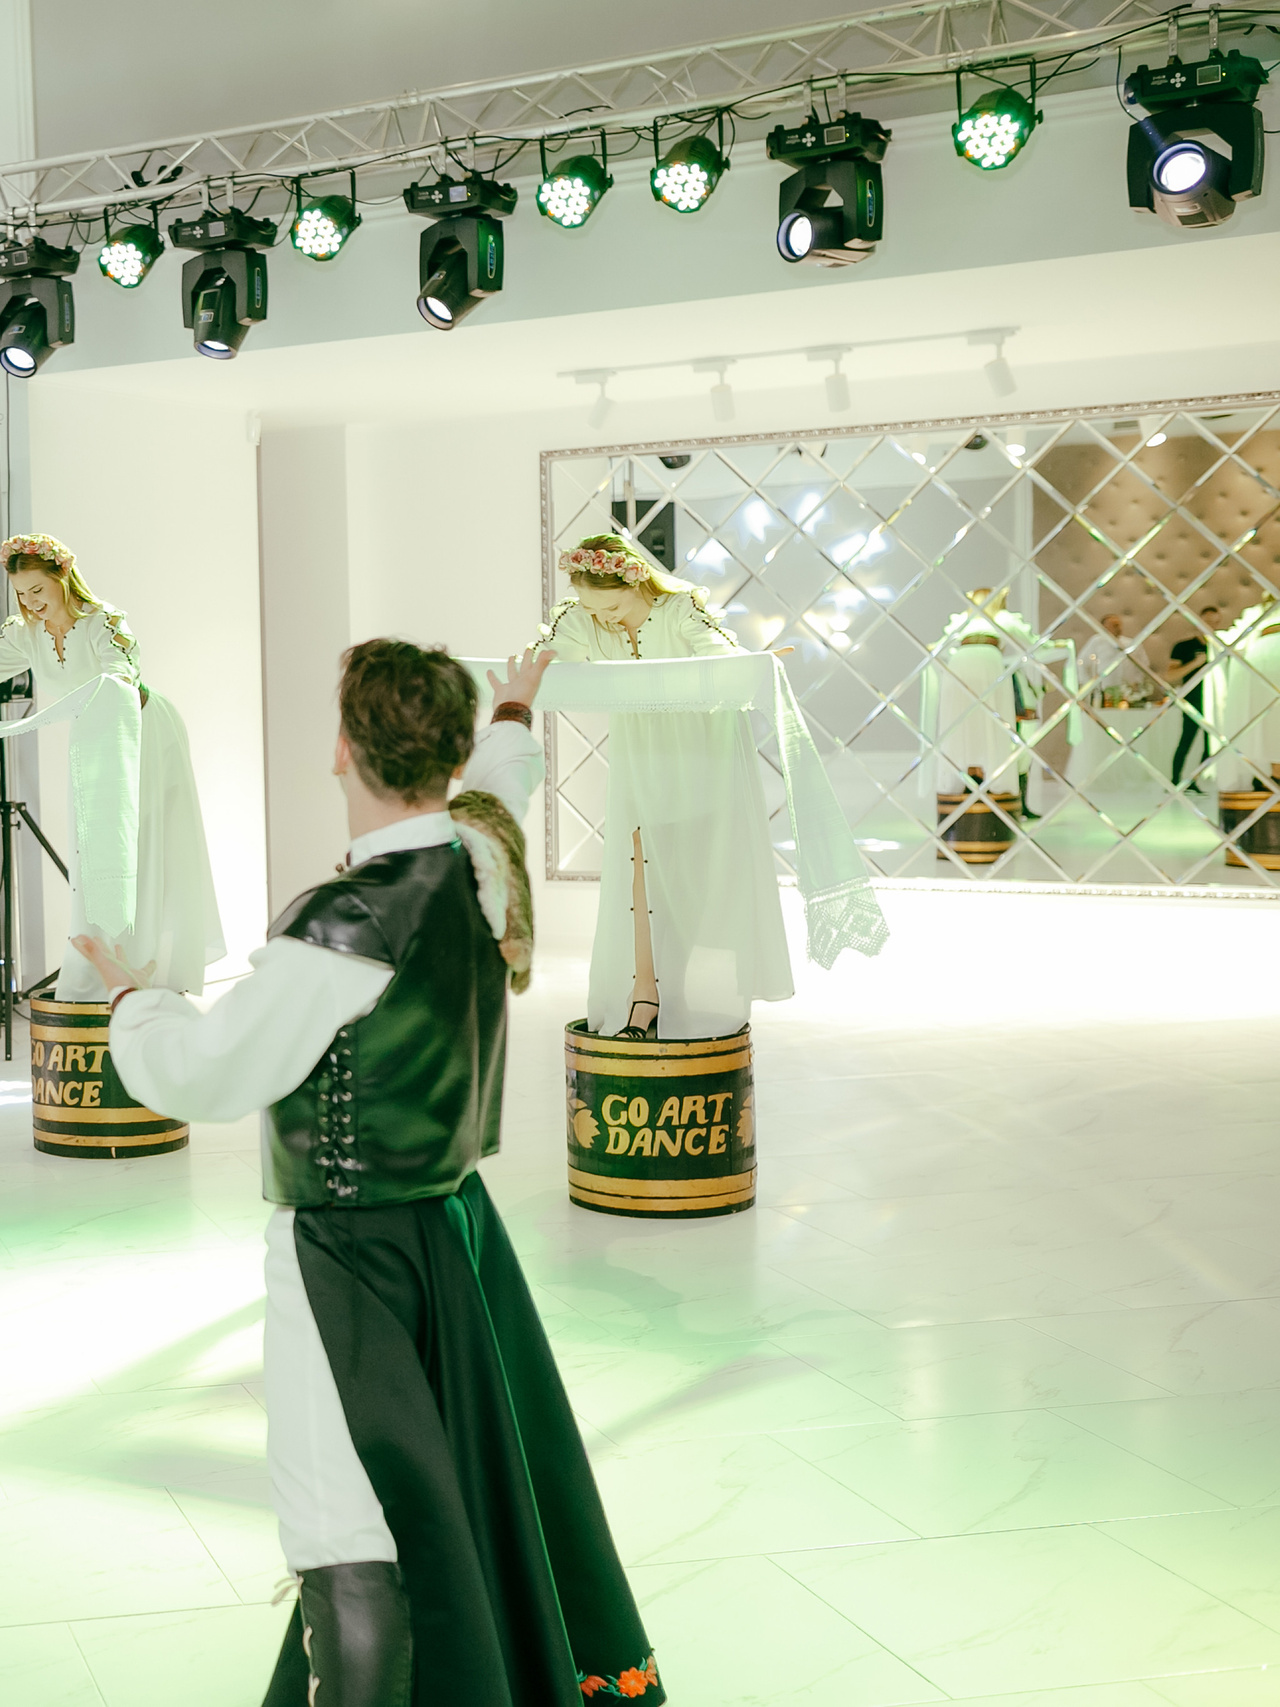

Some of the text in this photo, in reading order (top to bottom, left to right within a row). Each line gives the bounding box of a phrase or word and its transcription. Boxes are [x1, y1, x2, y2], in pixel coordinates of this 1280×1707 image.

[47, 1044, 110, 1073] ART
[601, 1092, 733, 1127] GO ART
[605, 1124, 729, 1157] DANCE
